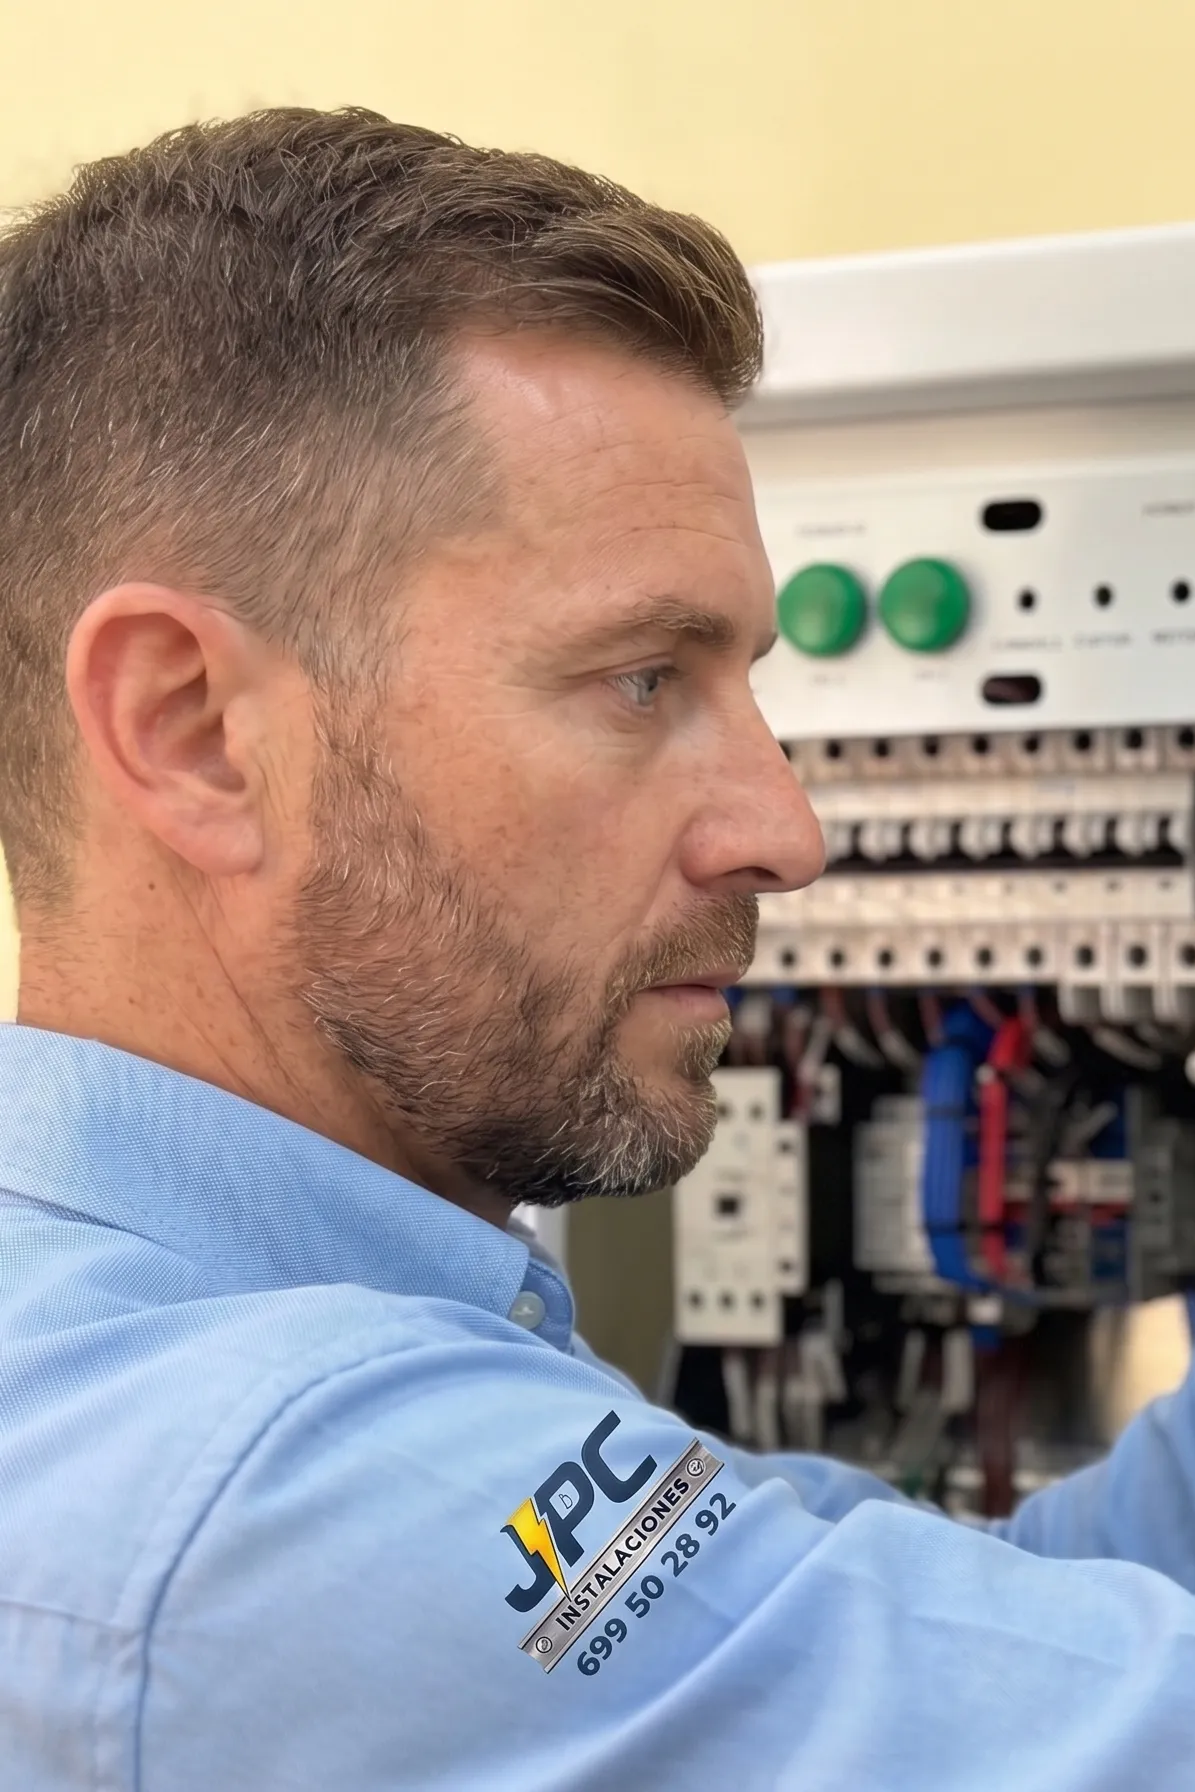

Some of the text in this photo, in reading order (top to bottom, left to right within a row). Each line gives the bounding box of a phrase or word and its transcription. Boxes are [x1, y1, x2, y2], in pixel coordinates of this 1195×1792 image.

[500, 1410, 658, 1613] JPC
[555, 1477, 690, 1632] INSTALACIONES
[576, 1492, 737, 1677] 699 50 28 92
